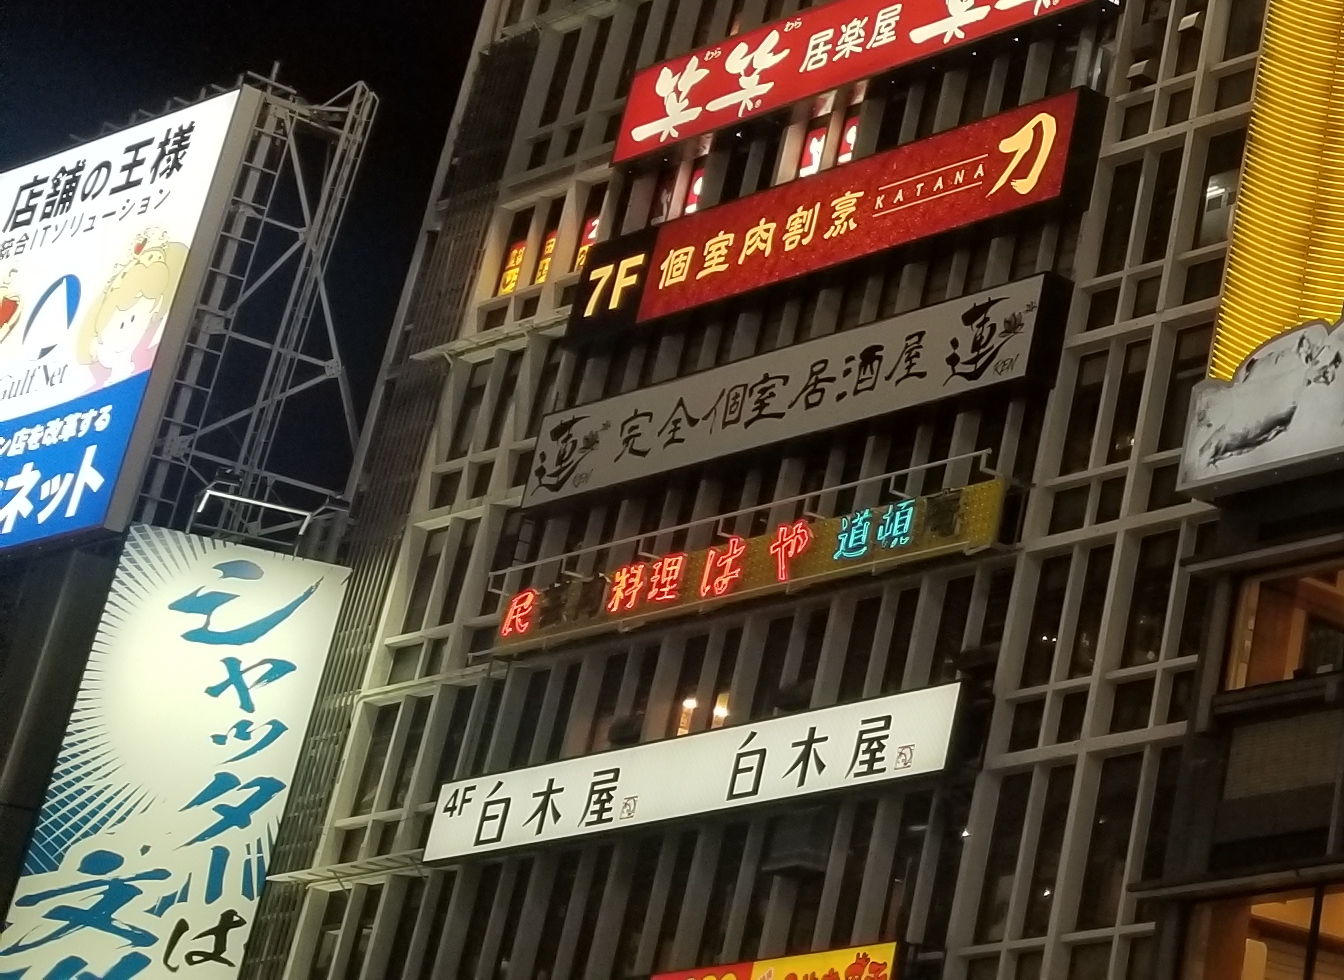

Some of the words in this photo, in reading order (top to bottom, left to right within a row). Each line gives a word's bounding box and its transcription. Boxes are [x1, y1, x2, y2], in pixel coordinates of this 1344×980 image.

[799, 3, 903, 73] 居楽屋
[2, 120, 196, 233] 店舗の王様
[583, 252, 646, 318] 7F
[658, 190, 865, 290] 個室肉割烹
[875, 163, 985, 210] KATANA
[985, 112, 1057, 198] 刀
[614, 330, 929, 464] 完全個室居酒屋
[442, 785, 477, 819] 4F
[473, 767, 621, 848] 白木屋
[726, 714, 893, 802] 白木屋
